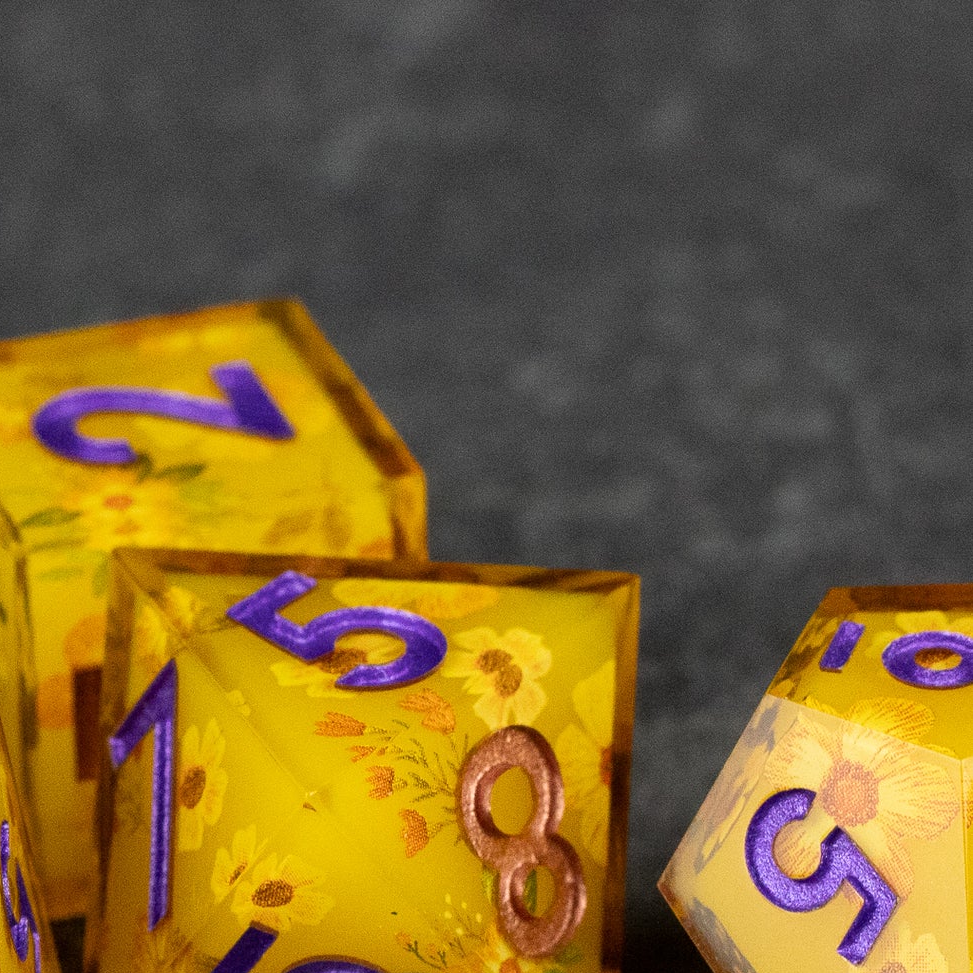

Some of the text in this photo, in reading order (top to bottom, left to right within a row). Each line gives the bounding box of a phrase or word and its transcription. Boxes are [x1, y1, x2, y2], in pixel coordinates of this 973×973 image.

[32, 361, 294, 464] 2
[227, 569, 448, 690] 5
[108, 658, 178, 932] 1
[457, 724, 587, 956] 8
[743, 788, 900, 967] 5
